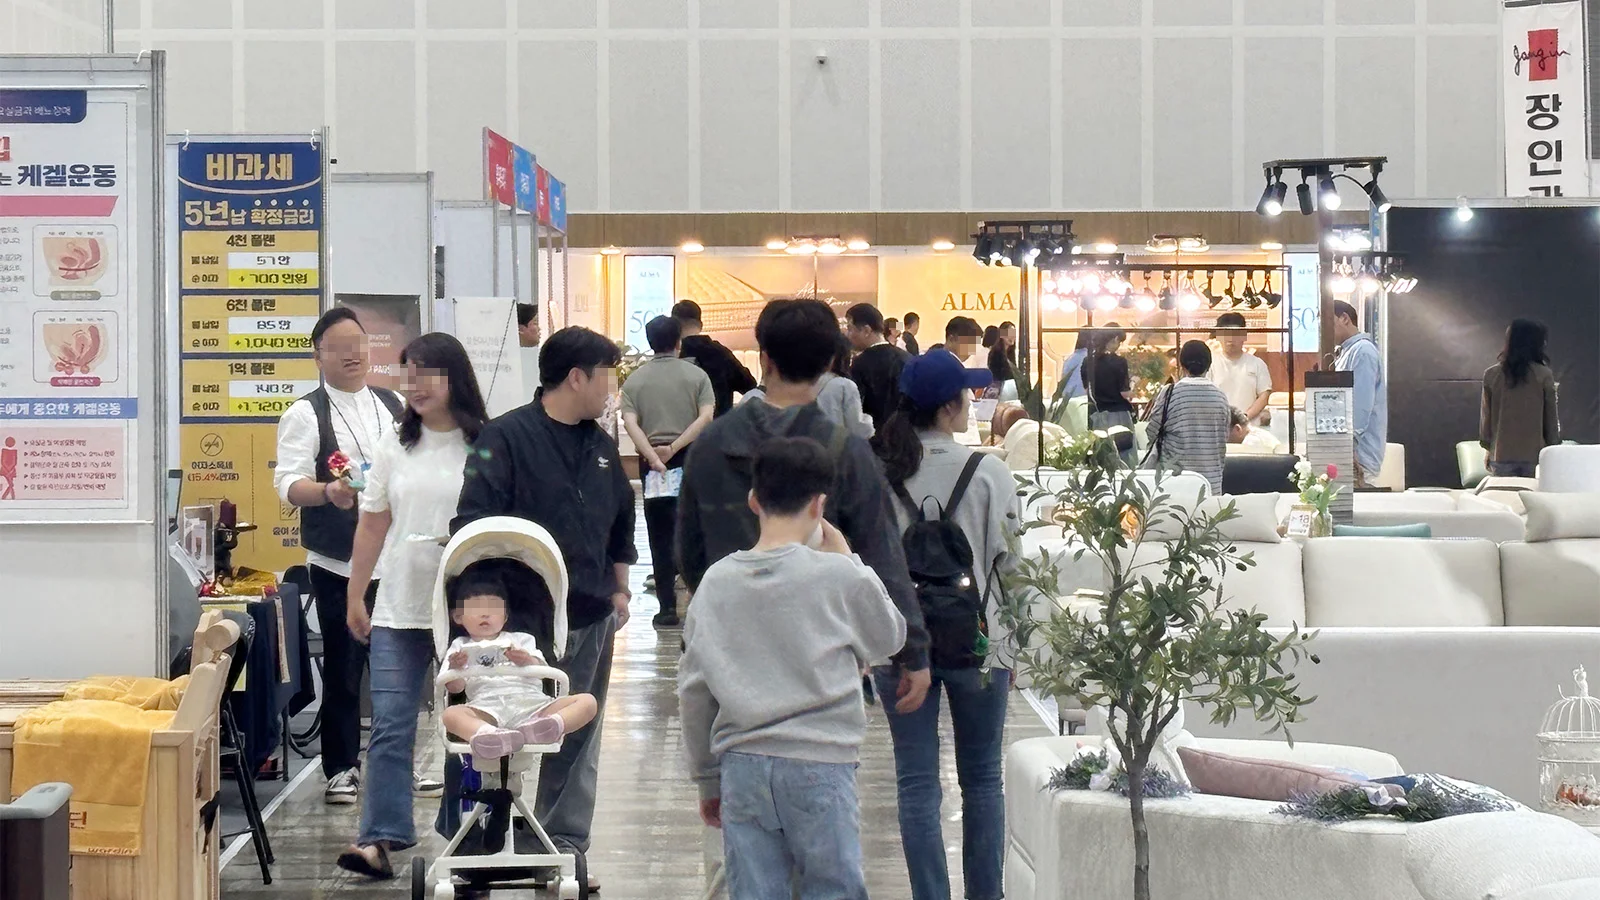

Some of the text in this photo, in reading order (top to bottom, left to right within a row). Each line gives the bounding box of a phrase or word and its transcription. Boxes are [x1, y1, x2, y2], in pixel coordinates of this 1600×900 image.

[206, 153, 293, 181] 비과세
[17, 164, 117, 187] 케겔운동
[251, 209, 315, 226] 확정금리
[251, 234, 276, 247] 플랜
[251, 299, 276, 311] 플랜
[940, 292, 1016, 310] ALMA
[228, 363, 275, 375] 1억 플랜
[73, 403, 121, 415] 케겔운동
